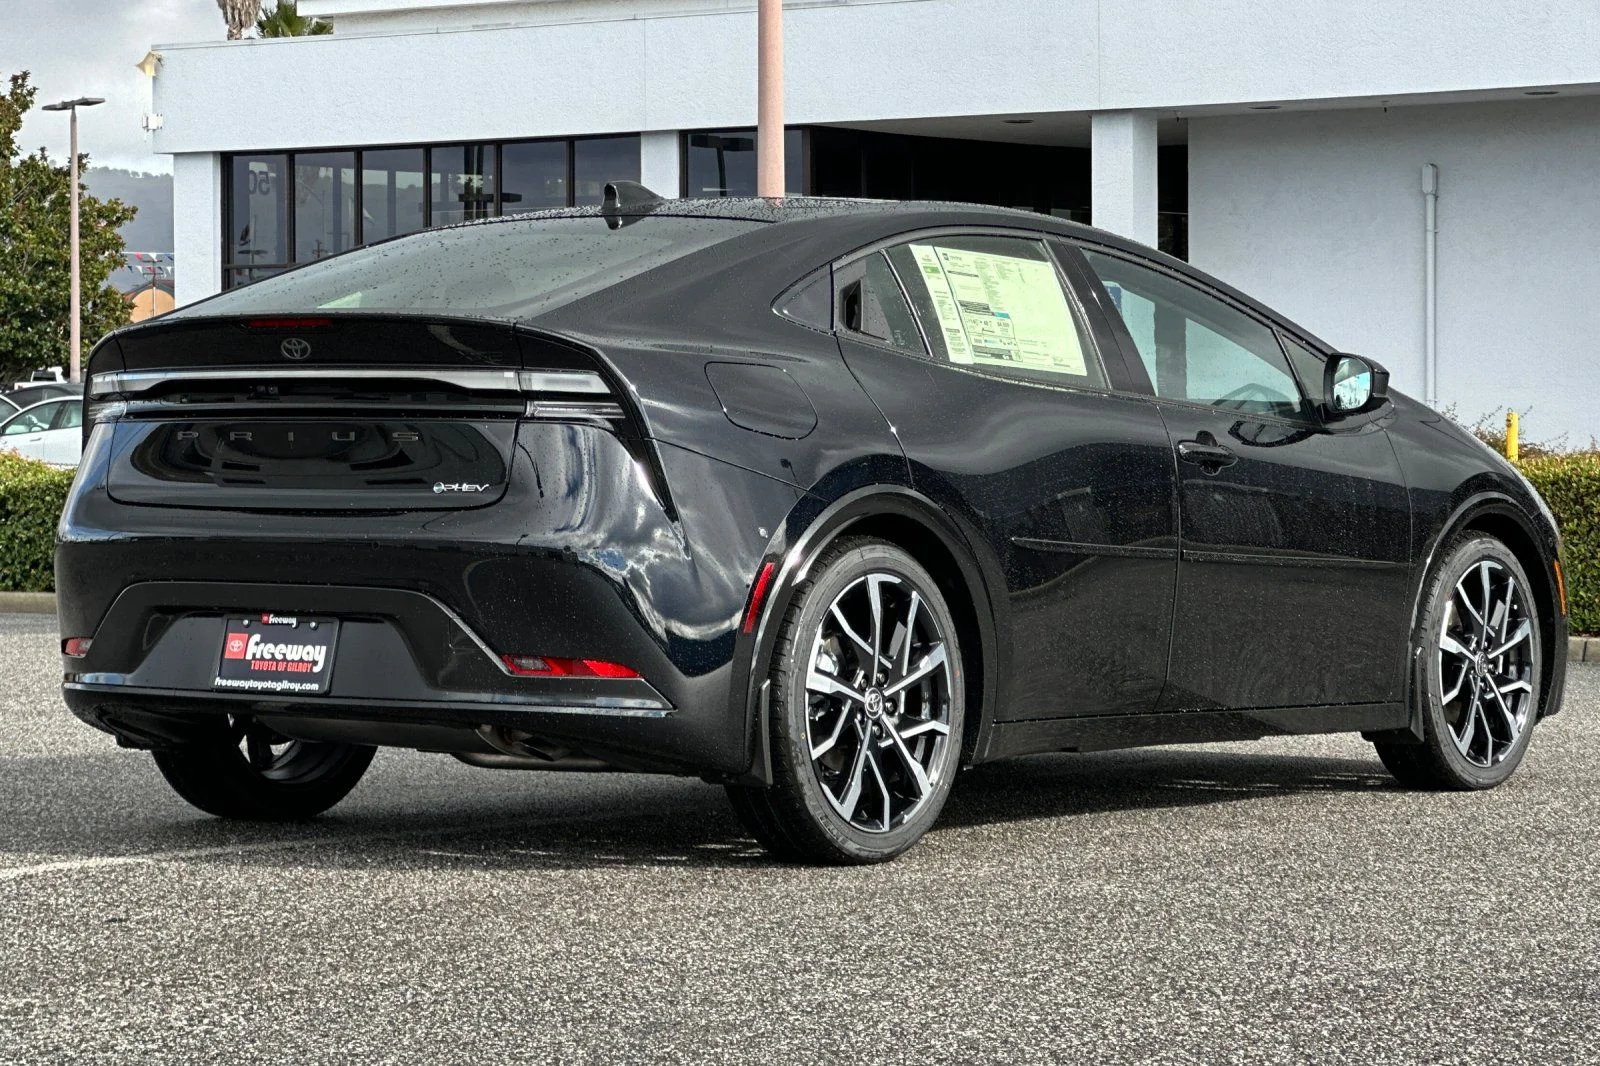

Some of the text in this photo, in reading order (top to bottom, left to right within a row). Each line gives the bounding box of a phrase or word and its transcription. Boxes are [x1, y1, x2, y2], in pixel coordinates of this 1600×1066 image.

[177, 431, 419, 441] PRIUS
[268, 614, 297, 628] freeway
[245, 633, 327, 673] freeway
[251, 660, 313, 673] TOYOTA OF GILROY
[214, 677, 319, 692] freewaytoyotagilroy.com
